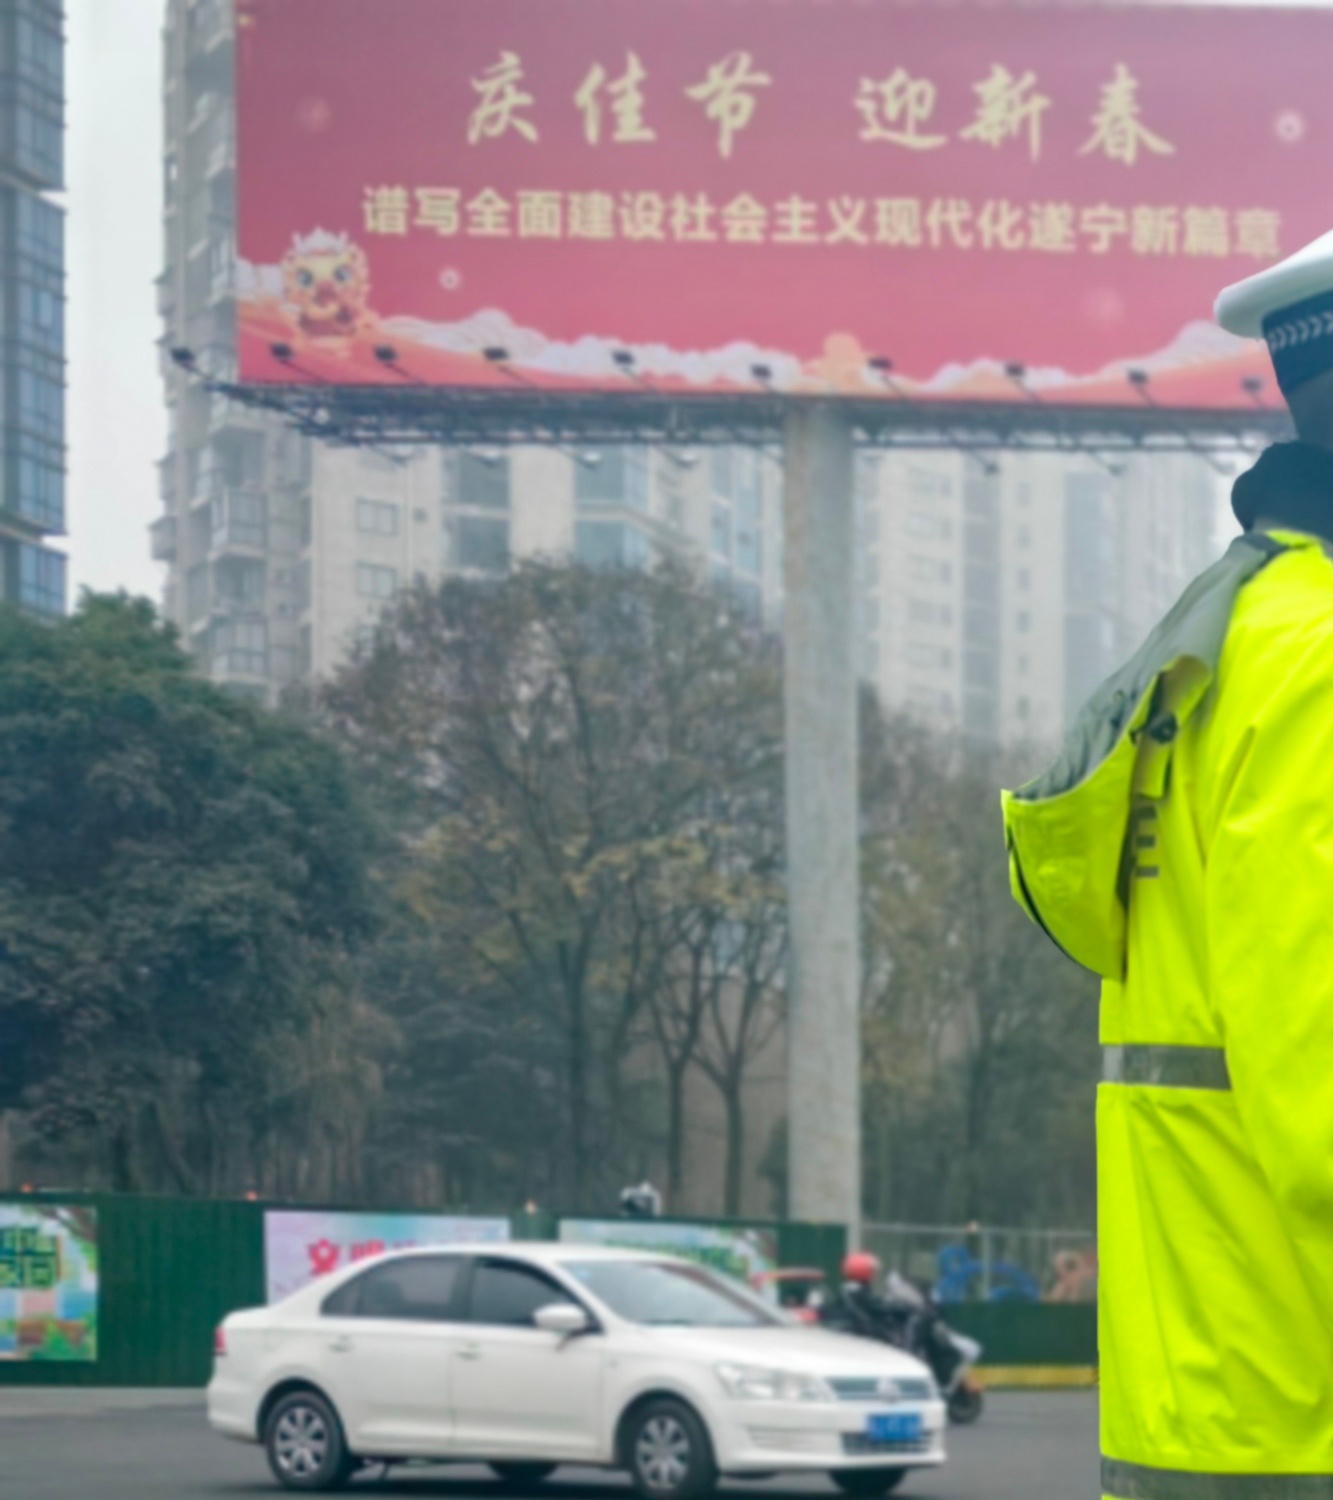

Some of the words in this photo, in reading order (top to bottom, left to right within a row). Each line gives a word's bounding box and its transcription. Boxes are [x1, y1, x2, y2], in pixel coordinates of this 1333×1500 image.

[467, 50, 772, 158] 庆佳节
[853, 63, 1177, 165] 迎新春
[363, 186, 1283, 259] 谱写全面建设社会主义现代化遂宁新篇章
